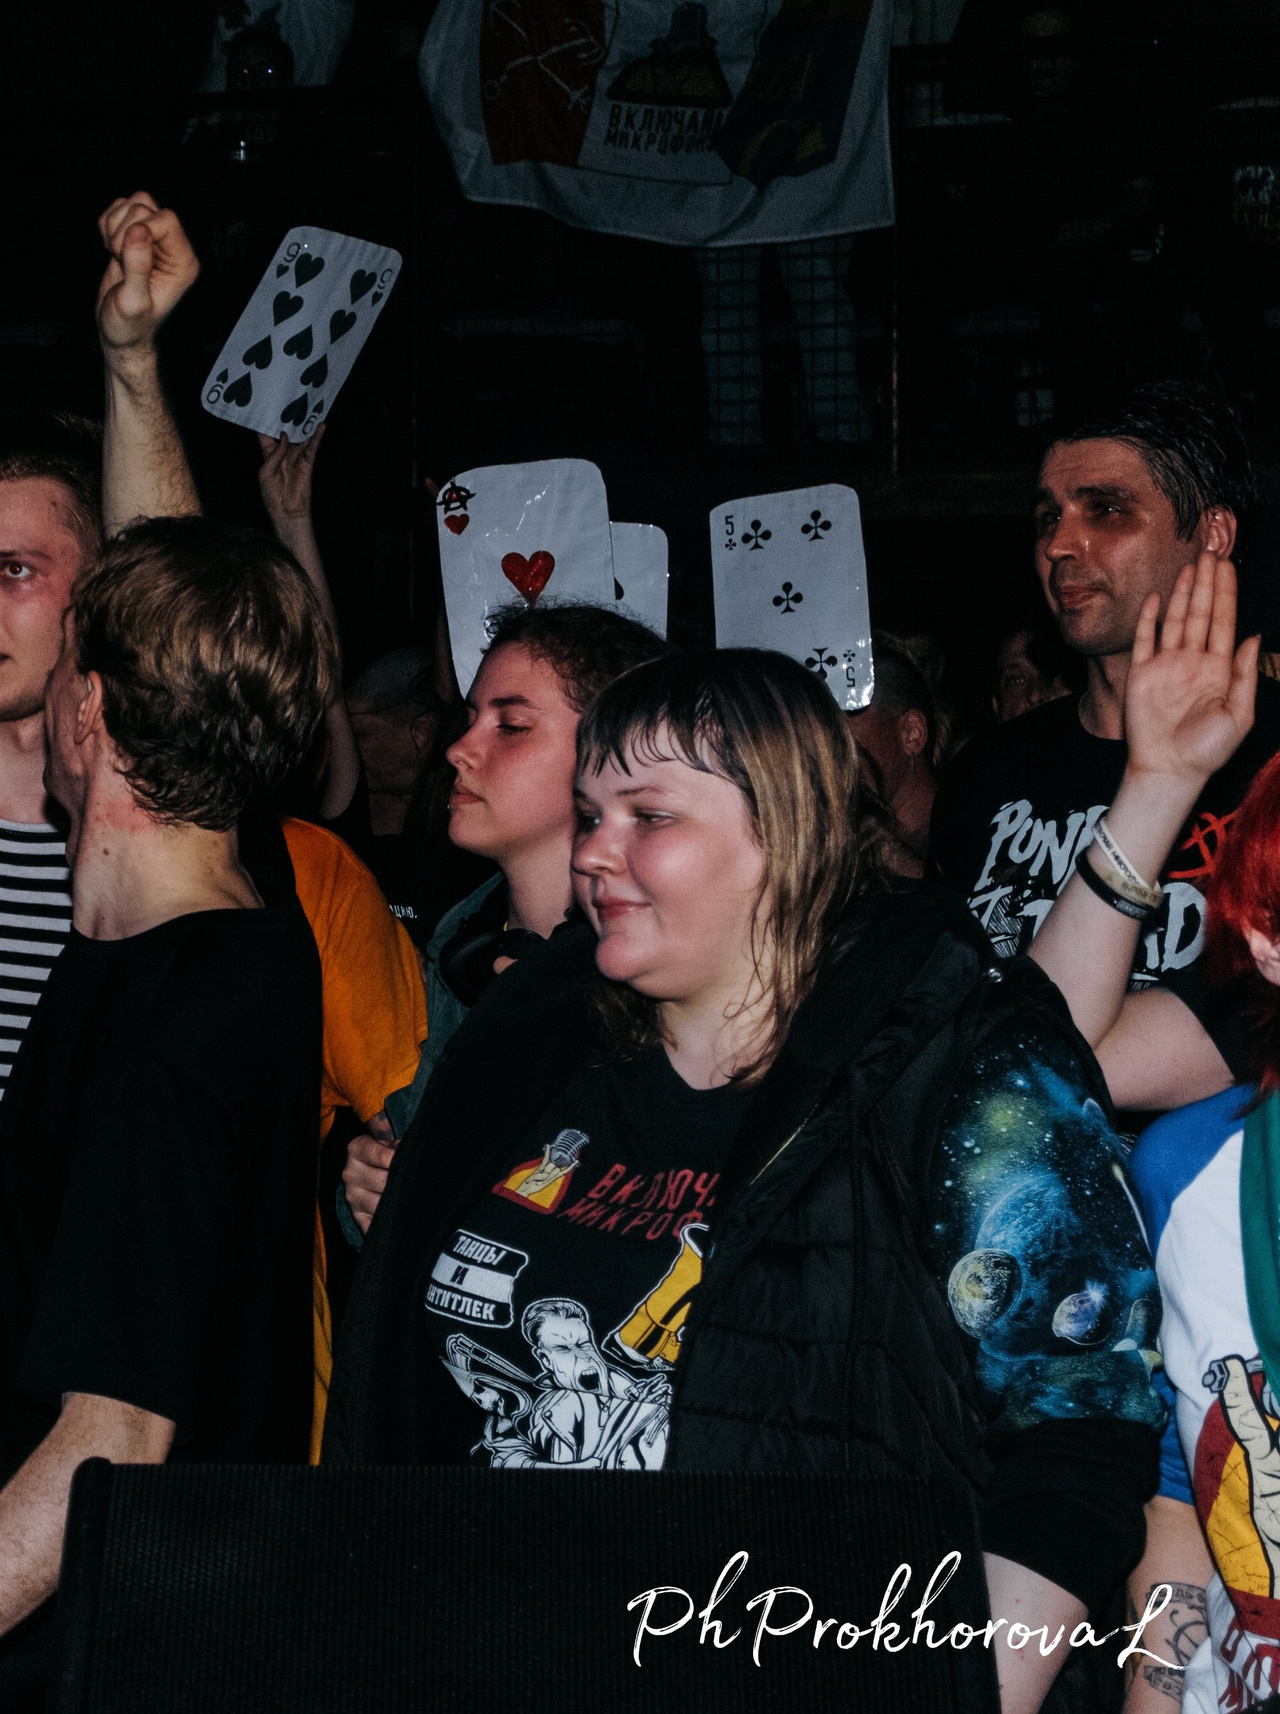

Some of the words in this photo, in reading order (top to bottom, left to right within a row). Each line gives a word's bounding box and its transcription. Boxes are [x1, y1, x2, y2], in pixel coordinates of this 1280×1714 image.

[724, 515, 735, 536] 5
[452, 1235, 507, 1266] ТАНЦЫ
[450, 1265, 469, 1286] И
